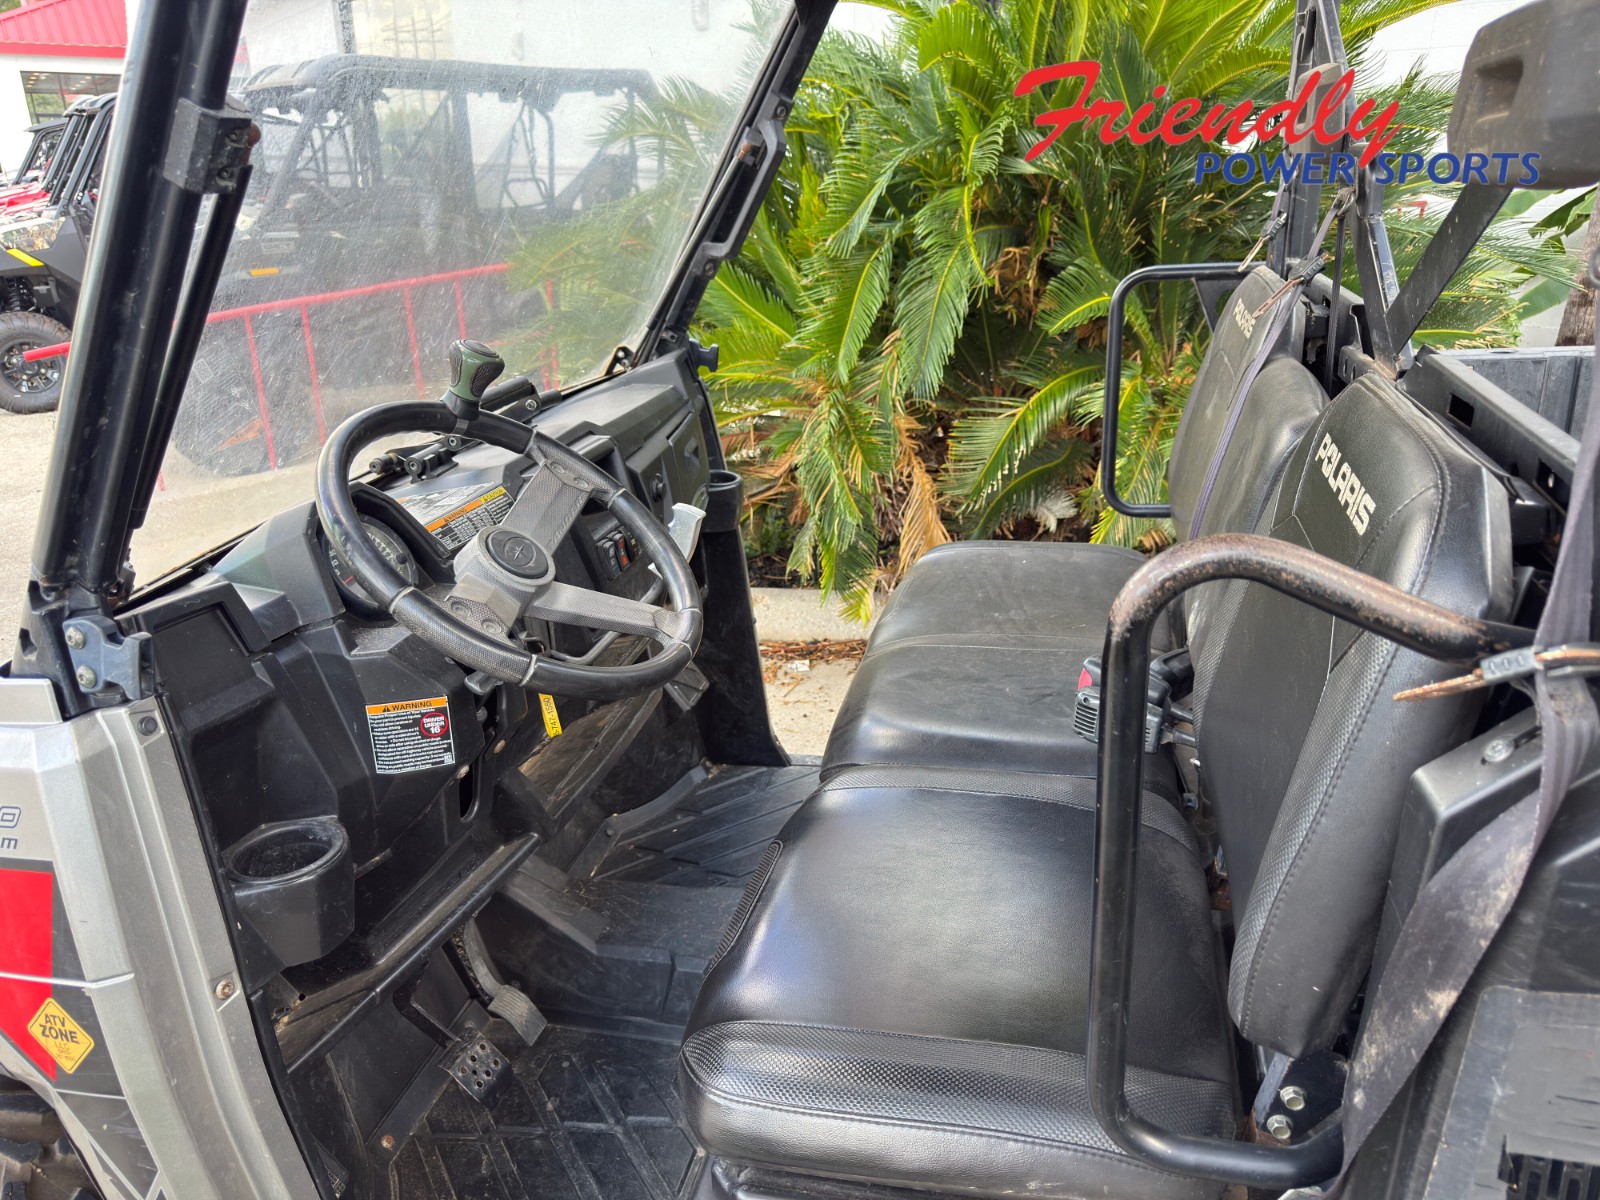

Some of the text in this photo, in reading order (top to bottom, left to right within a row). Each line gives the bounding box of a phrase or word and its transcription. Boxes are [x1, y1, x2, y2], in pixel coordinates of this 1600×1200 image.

[1232, 297, 1257, 339] POLARIS
[1314, 431, 1377, 536] POLARIS
[392, 701, 432, 711] WARNING
[423, 716, 445, 724] DRIVER
[429, 726, 441, 734] 16
[44, 1012, 66, 1028] ATV
[39, 1023, 81, 1045] ZONE
